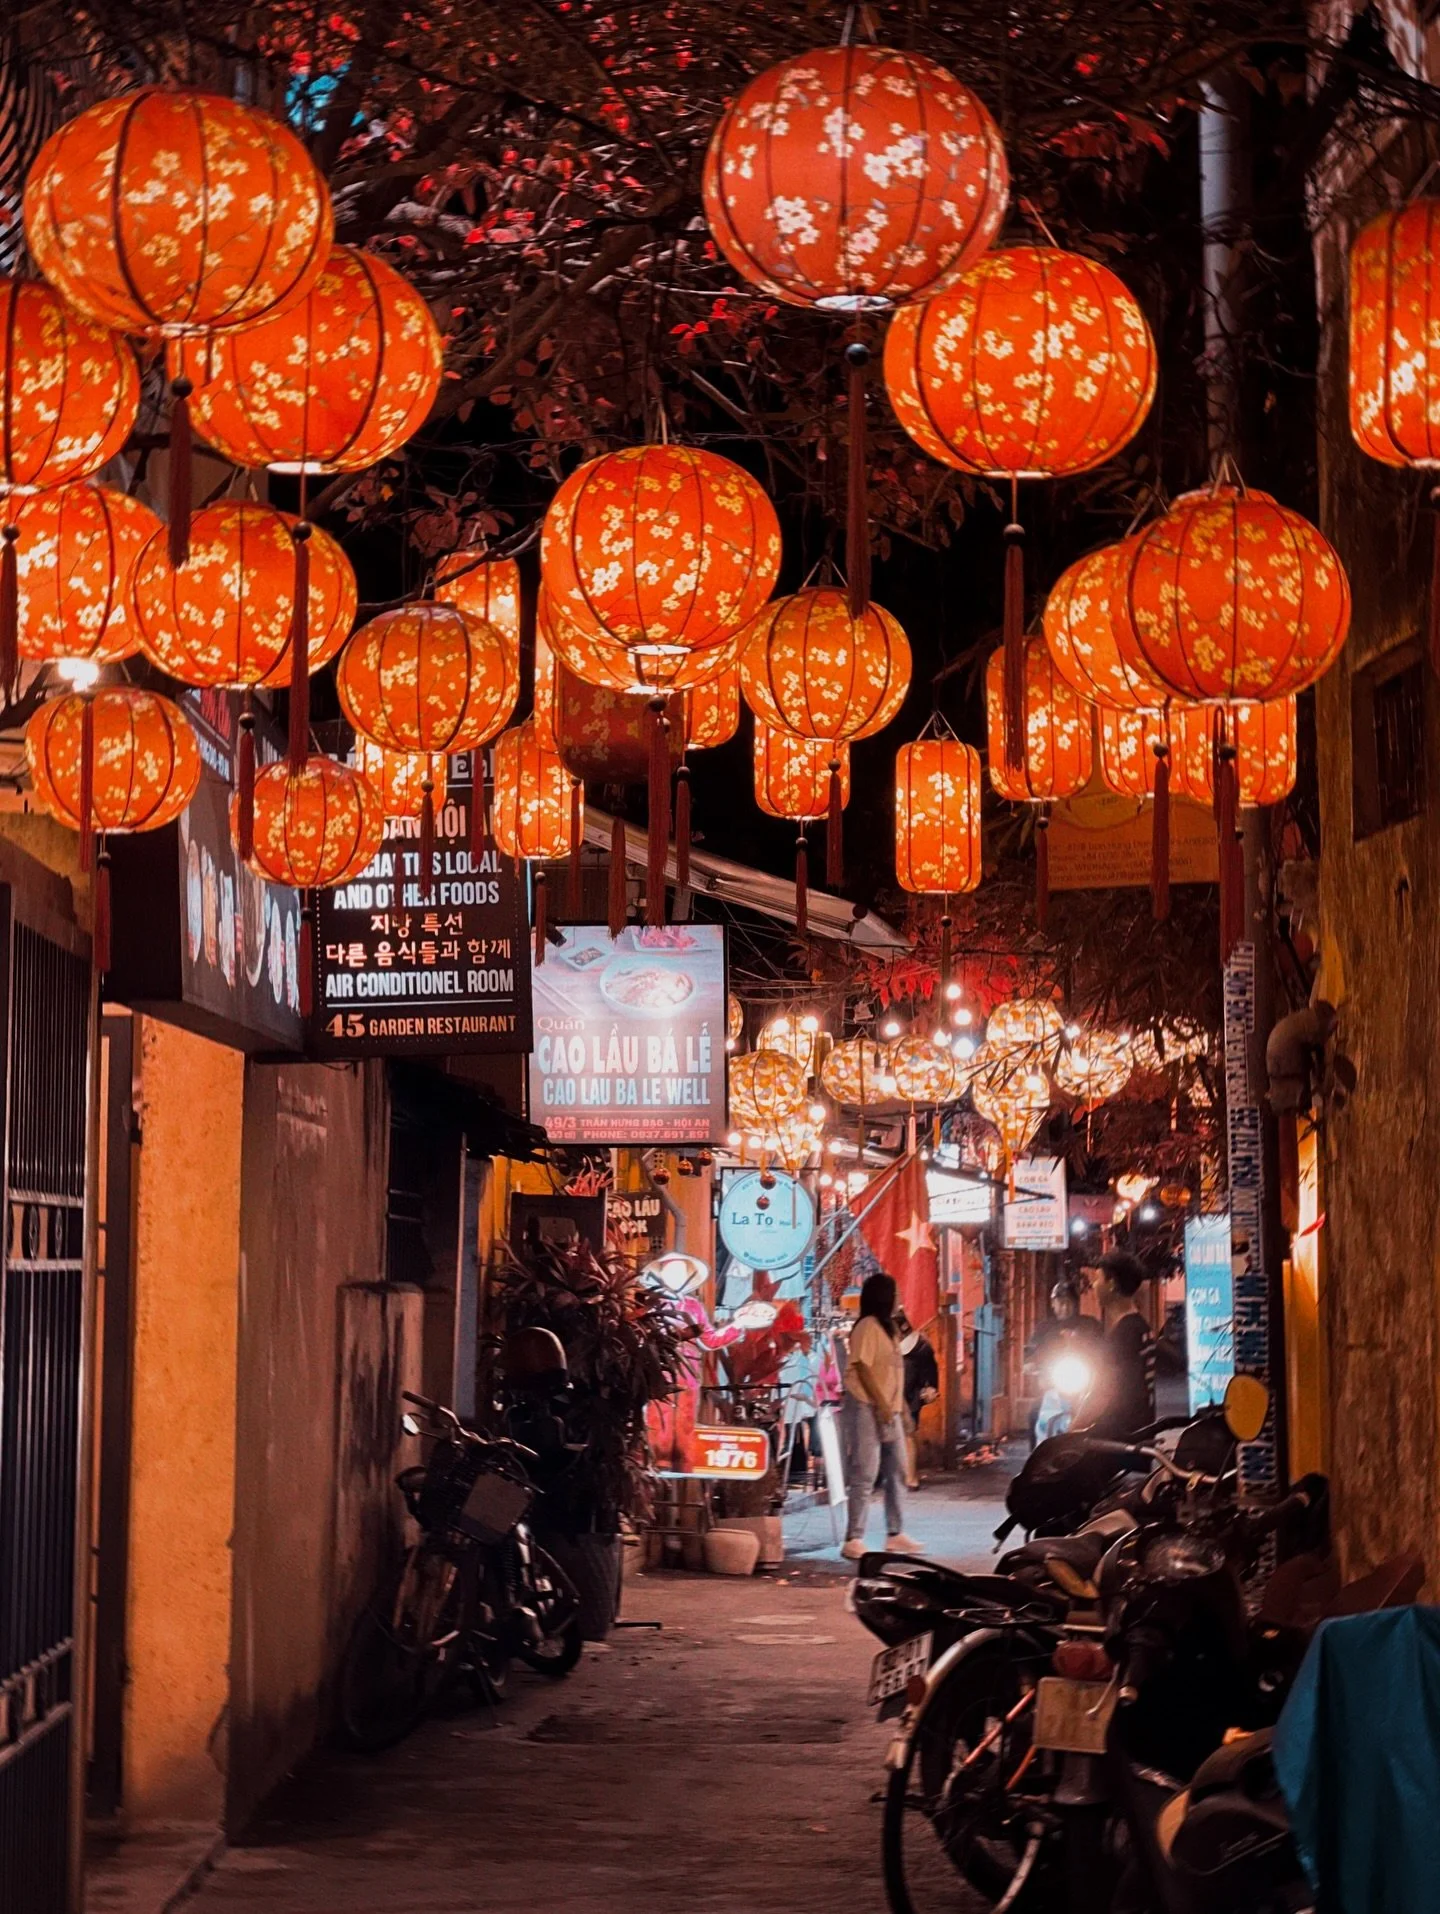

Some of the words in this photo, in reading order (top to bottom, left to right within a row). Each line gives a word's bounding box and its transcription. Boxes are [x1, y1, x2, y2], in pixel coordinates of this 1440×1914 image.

[333, 883, 373, 909] AND
[440, 881, 500, 906] FOODS
[421, 912, 463, 936] 특선
[326, 942, 367, 968] 다른
[374, 940, 460, 966] 음식들과
[467, 938, 511, 964] 함께
[325, 973, 353, 998] AIR
[356, 971, 463, 997] CONDITIONEL
[467, 969, 514, 993] ROOM
[325, 1013, 365, 1038] 45
[369, 1017, 424, 1036] GARDEN
[427, 1015, 516, 1034] RESTAURANT
[537, 1016, 585, 1033] Quán
[537, 1035, 586, 1074] CAO
[647, 1027, 679, 1074] BÁ
[543, 1078, 577, 1105] CAO
[580, 1078, 611, 1105] LAU
[615, 1078, 638, 1105] BA
[642, 1078, 661, 1105] LE
[665, 1077, 711, 1105] WELL
[544, 1116, 576, 1129] 49/3
[694, 1118, 710, 1127] AN
[583, 1130, 628, 1139] PHONE:
[732, 1212, 749, 1225] La
[754, 1212, 773, 1226] To
[705, 1449, 758, 1468] 1976
